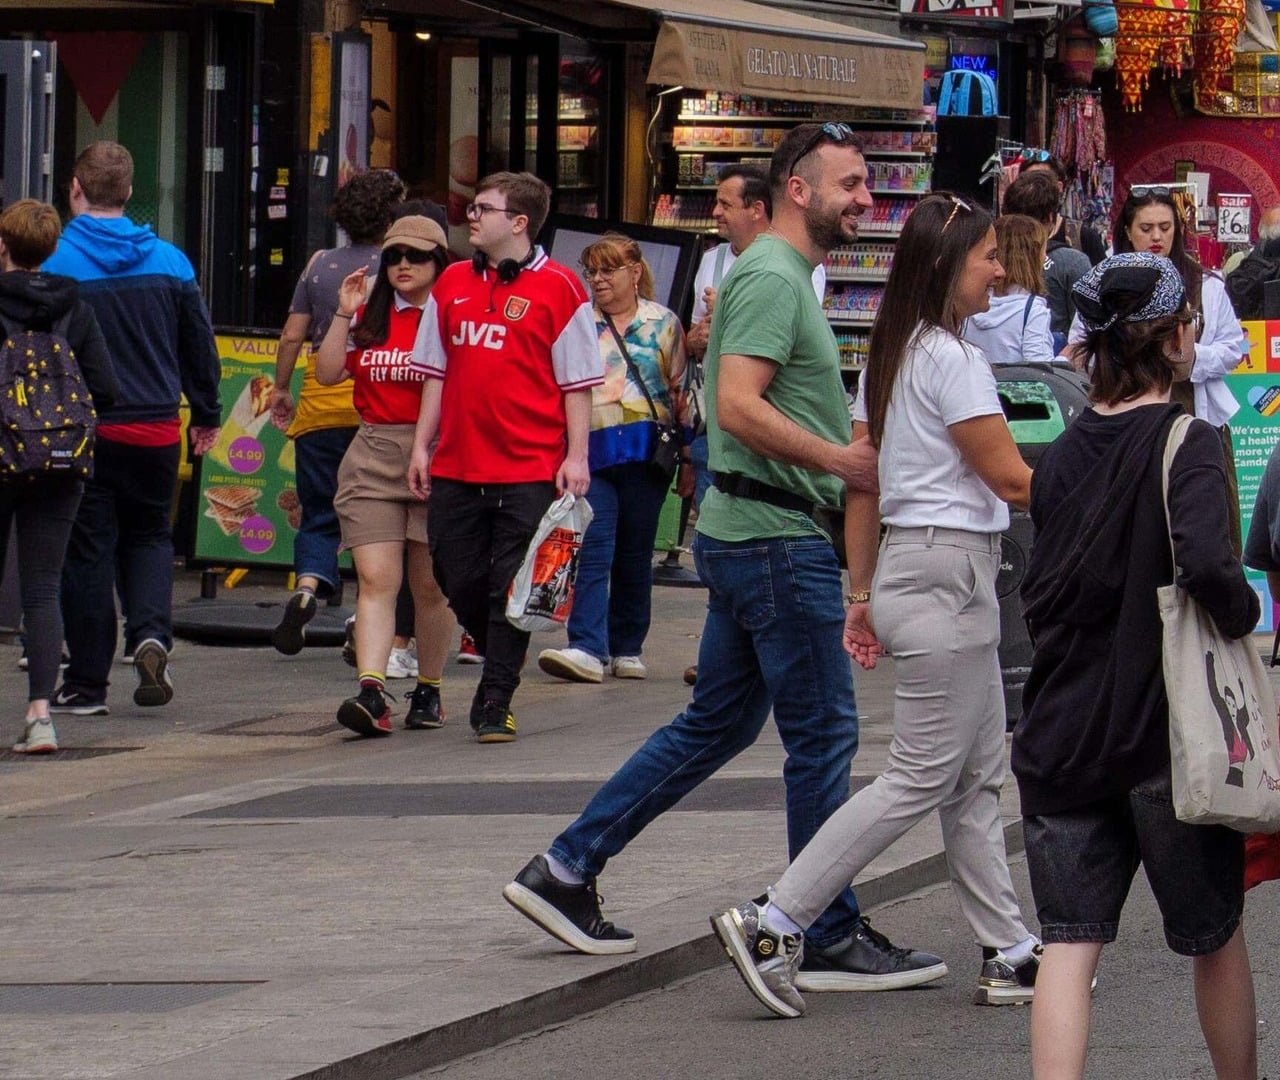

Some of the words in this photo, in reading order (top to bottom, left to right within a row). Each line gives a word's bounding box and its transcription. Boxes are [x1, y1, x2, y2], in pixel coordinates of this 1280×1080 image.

[747, 47, 786, 76] GELATO
[787, 50, 802, 78] AL
[802, 53, 856, 83] NATURALE
[951, 55, 986, 69] NEW
[1221, 196, 1248, 207] sale
[452, 321, 506, 350] JVC
[232, 339, 278, 356] VALU
[360, 348, 413, 366] Emira
[370, 367, 387, 382] FLY
[1232, 425, 1260, 435] We're
[1240, 438, 1245, 446] a
[1248, 436, 1280, 446] health
[229, 449, 262, 461] £4.99
[1236, 448, 1262, 456] more
[1234, 458, 1268, 467] Camde
[1242, 474, 1258, 482] Have
[240, 528, 273, 540] £4.99
